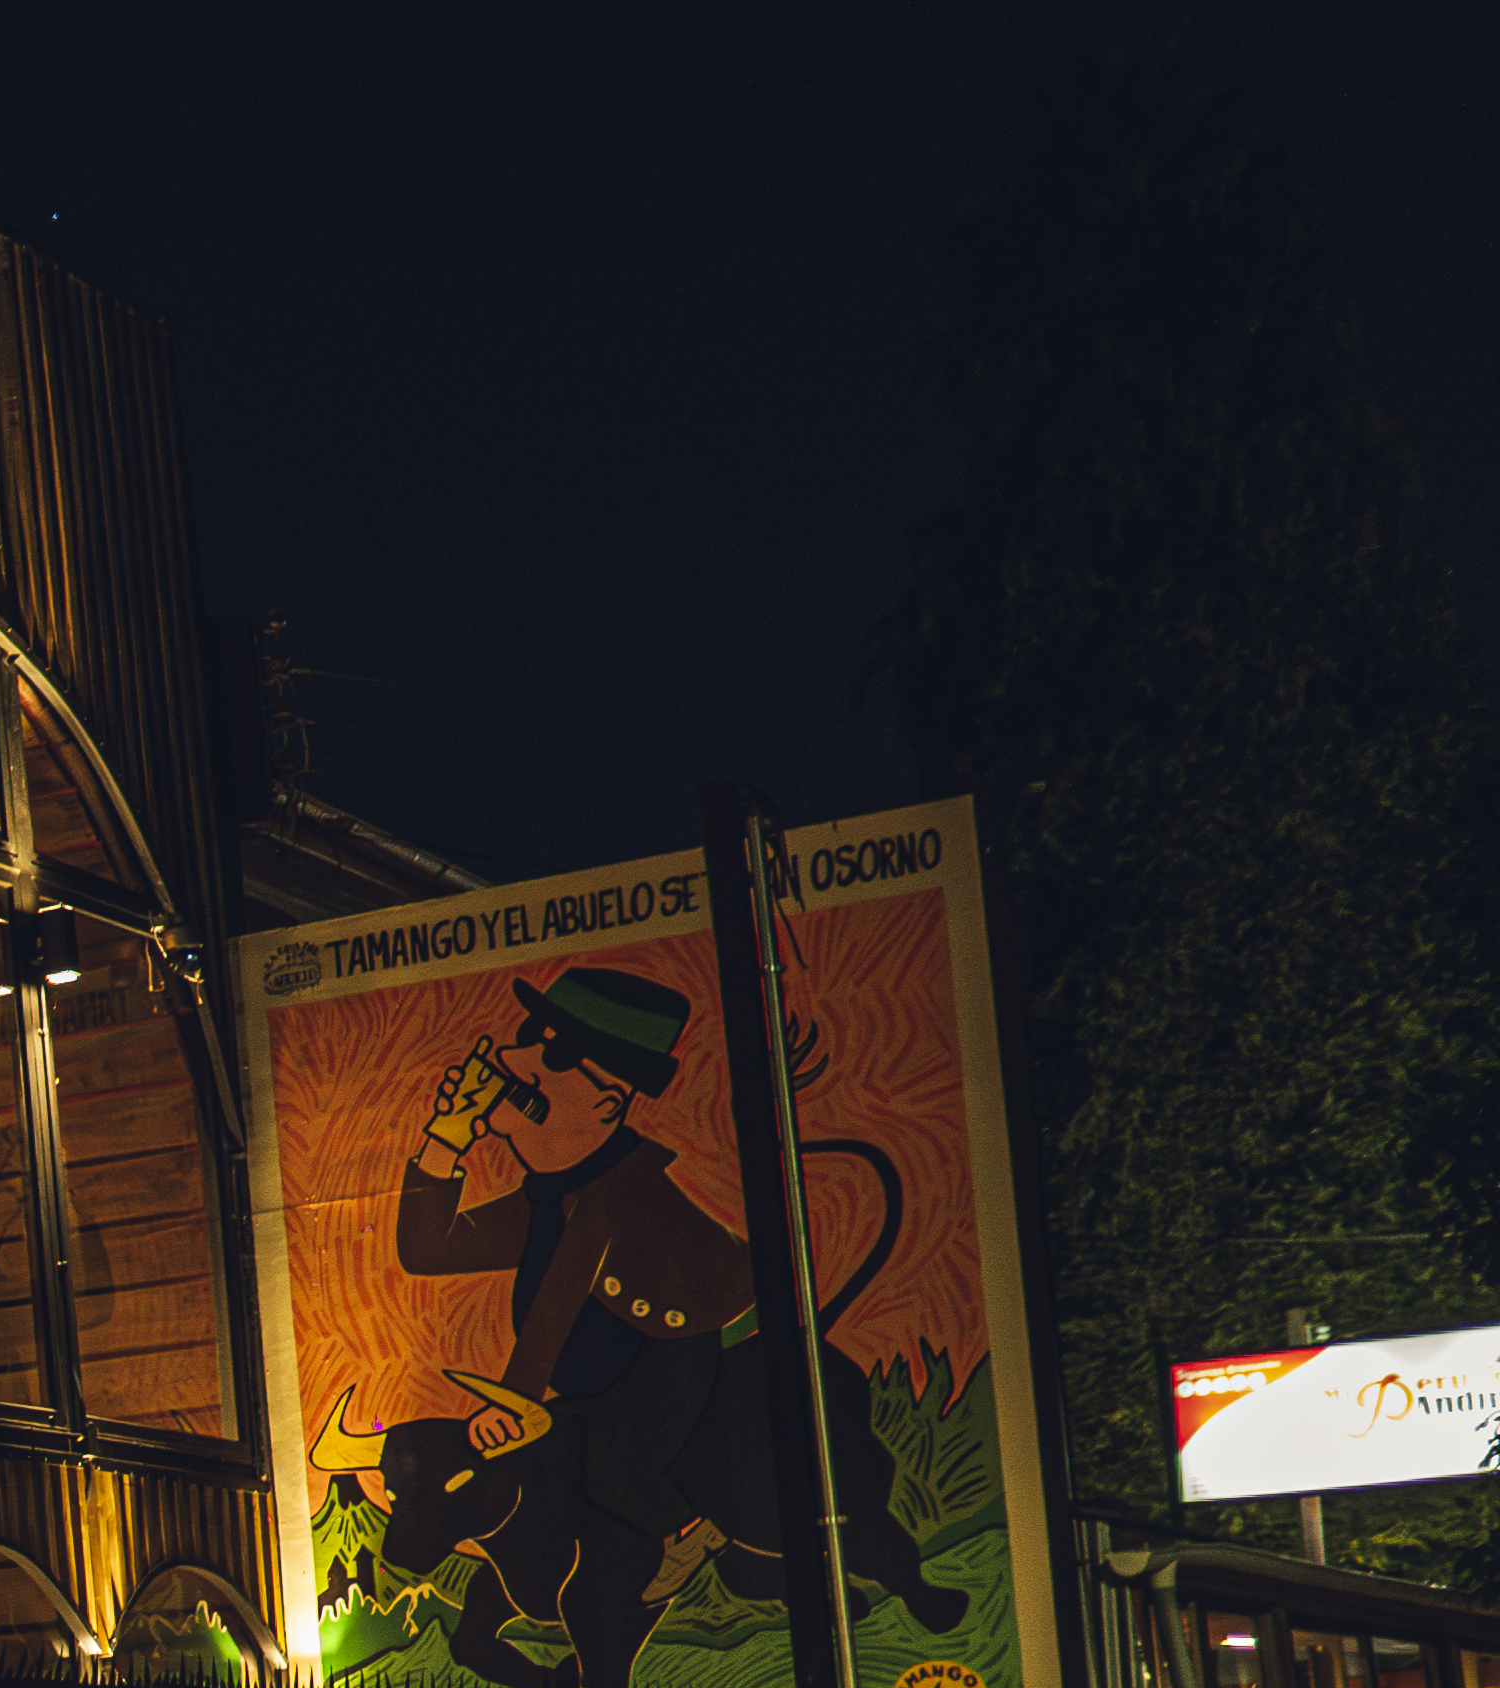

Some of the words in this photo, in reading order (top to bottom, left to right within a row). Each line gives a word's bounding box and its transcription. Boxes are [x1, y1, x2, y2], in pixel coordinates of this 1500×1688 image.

[324, 915, 476, 978] TAMANGO
[480, 909, 500, 950] Y
[504, 903, 537, 947] EL
[541, 881, 654, 941] ABUELO
[811, 828, 942, 891] OSORNO
